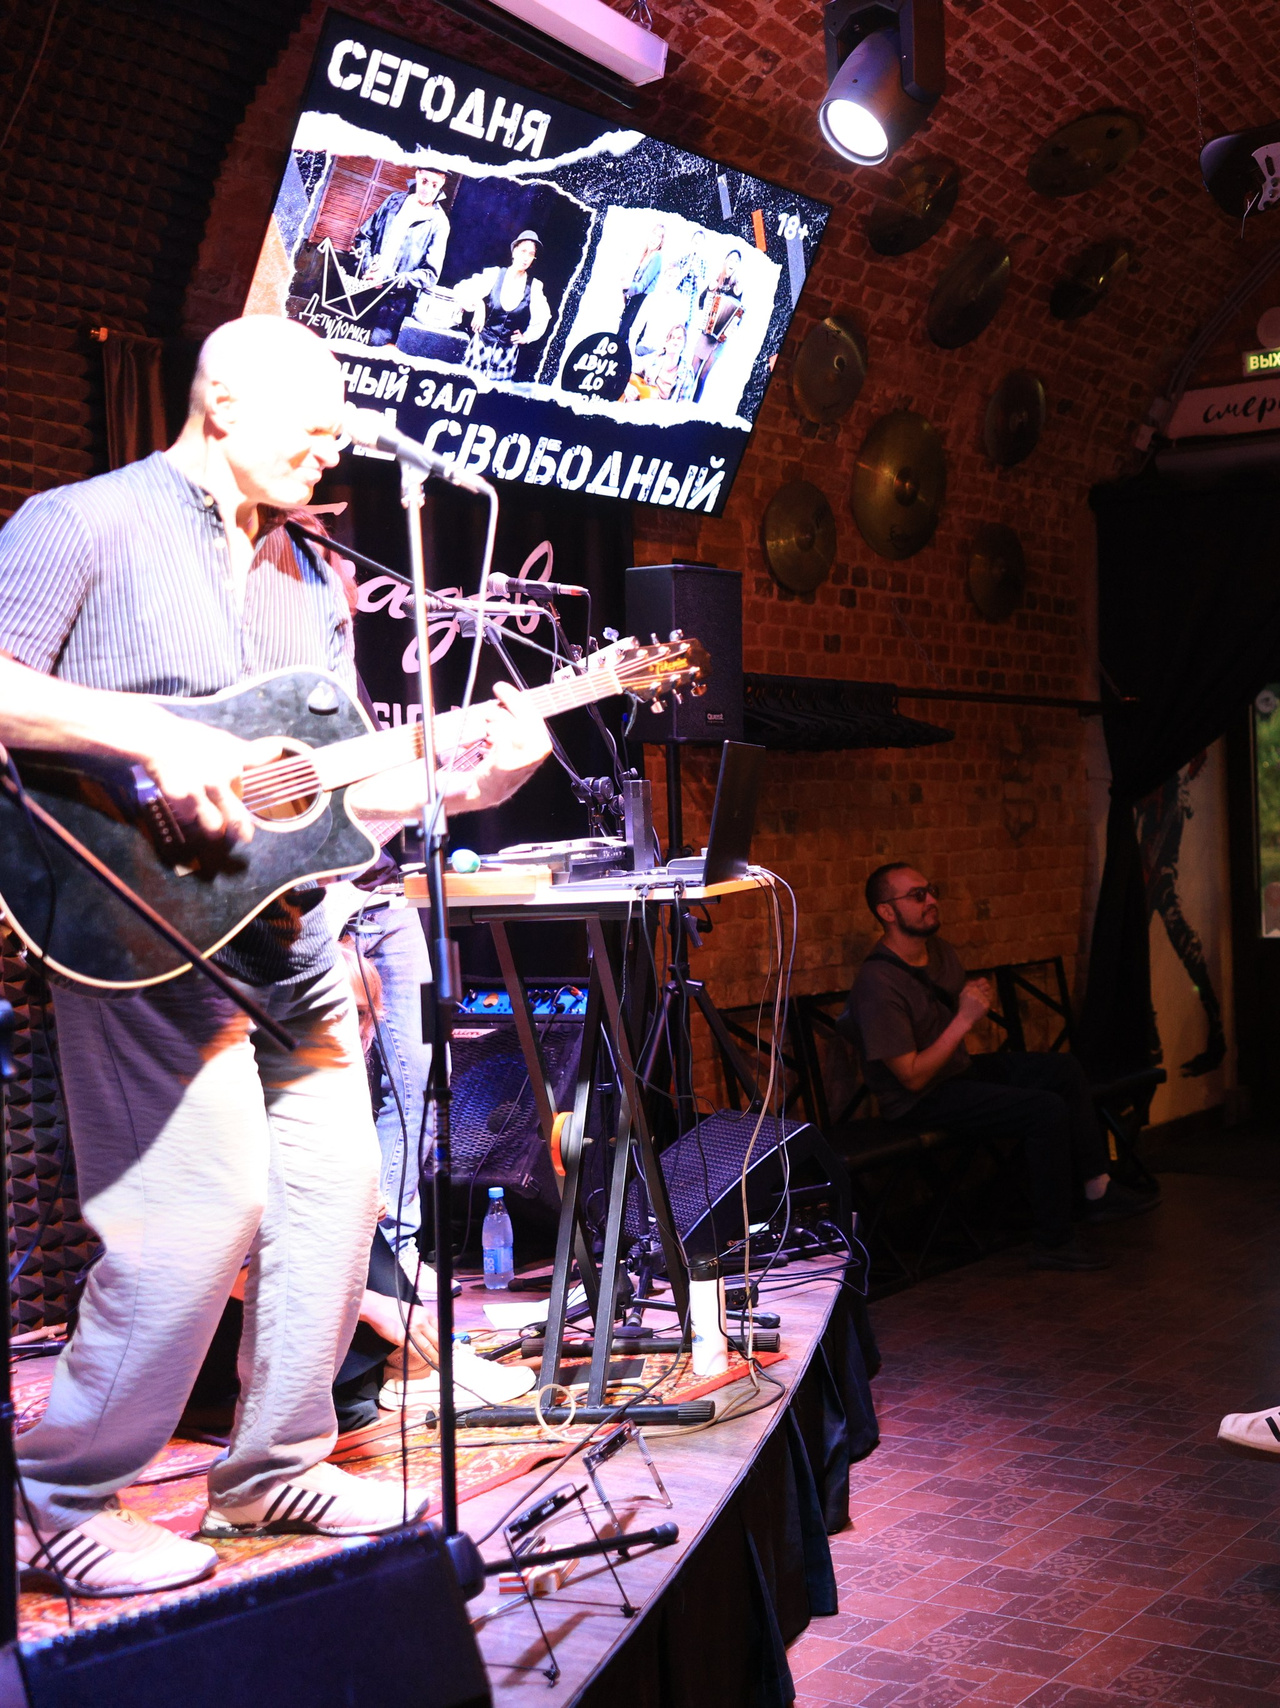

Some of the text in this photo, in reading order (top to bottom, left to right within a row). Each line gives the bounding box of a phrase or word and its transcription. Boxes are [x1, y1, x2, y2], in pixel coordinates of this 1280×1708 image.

[327, 39, 552, 159] СЕГОДНЯ
[777, 212, 809, 241] 18+
[340, 361, 477, 416] НЫЙ ЗАЛ
[422, 418, 728, 513] СВОБОДНЫЙ
